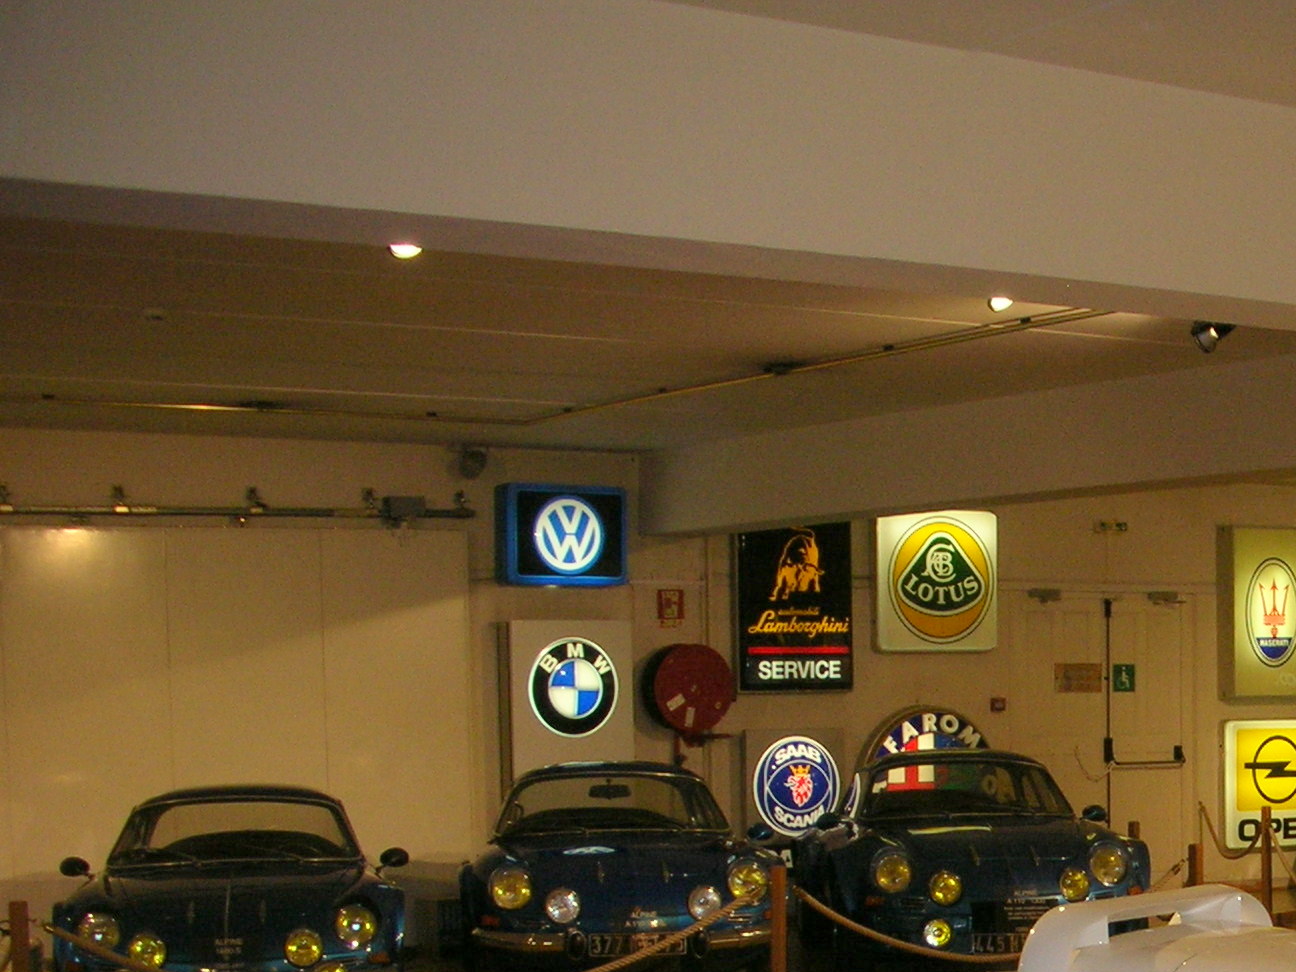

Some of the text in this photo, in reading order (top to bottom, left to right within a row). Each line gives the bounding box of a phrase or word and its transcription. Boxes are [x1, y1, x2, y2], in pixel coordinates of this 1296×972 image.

[904, 575, 981, 605] LOTUS
[748, 610, 849, 638] Lamborghini
[539, 642, 612, 675] BMW
[758, 660, 842, 680] SERVICE
[774, 743, 823, 766] SAAB
